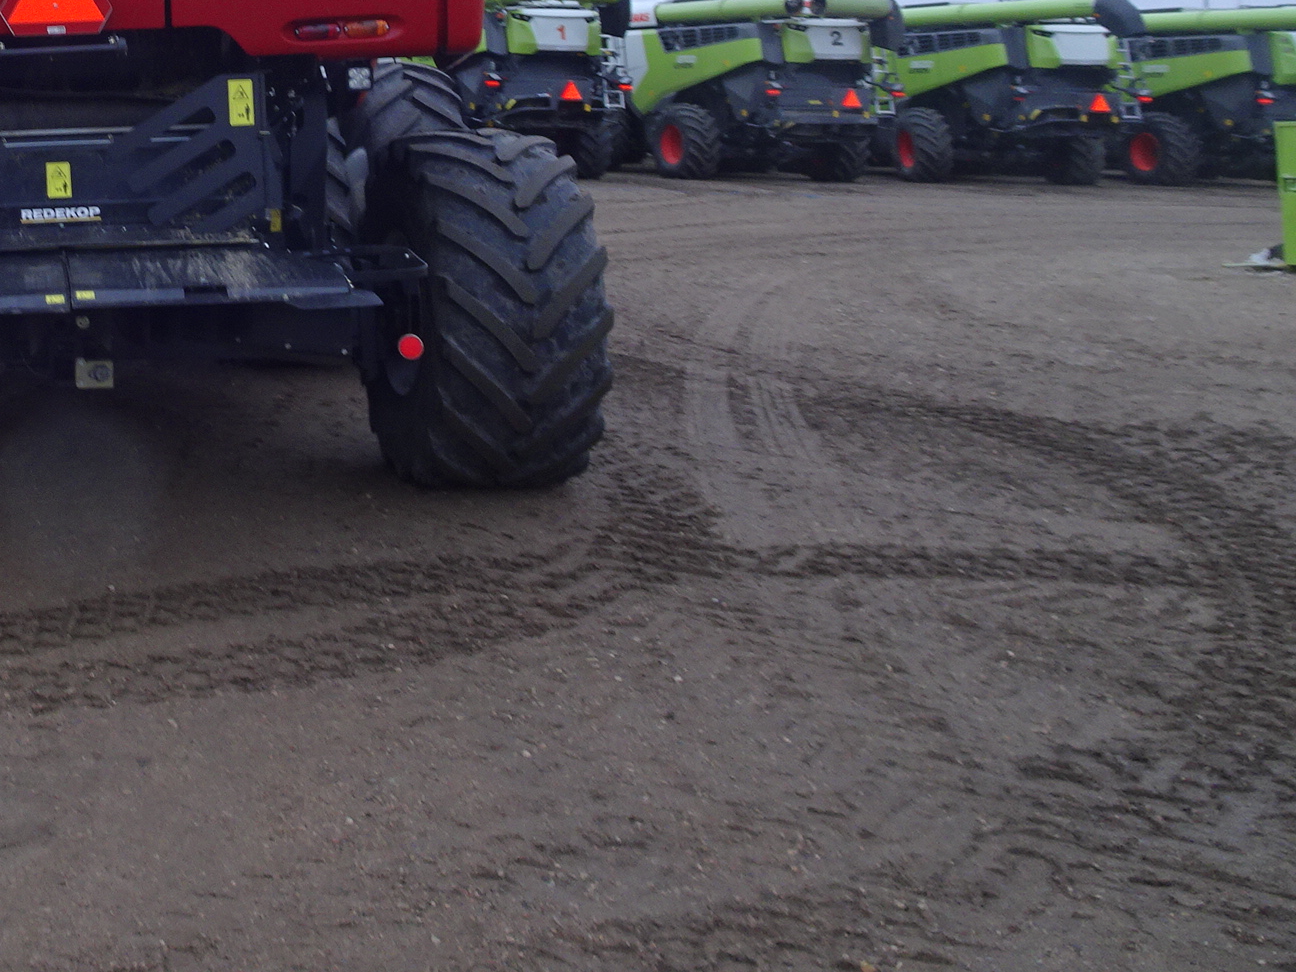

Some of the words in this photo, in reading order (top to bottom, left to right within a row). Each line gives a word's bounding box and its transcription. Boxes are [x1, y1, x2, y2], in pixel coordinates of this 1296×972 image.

[556, 24, 567, 41] 1
[830, 30, 844, 46] 2
[20, 205, 101, 220] REDEKOP
